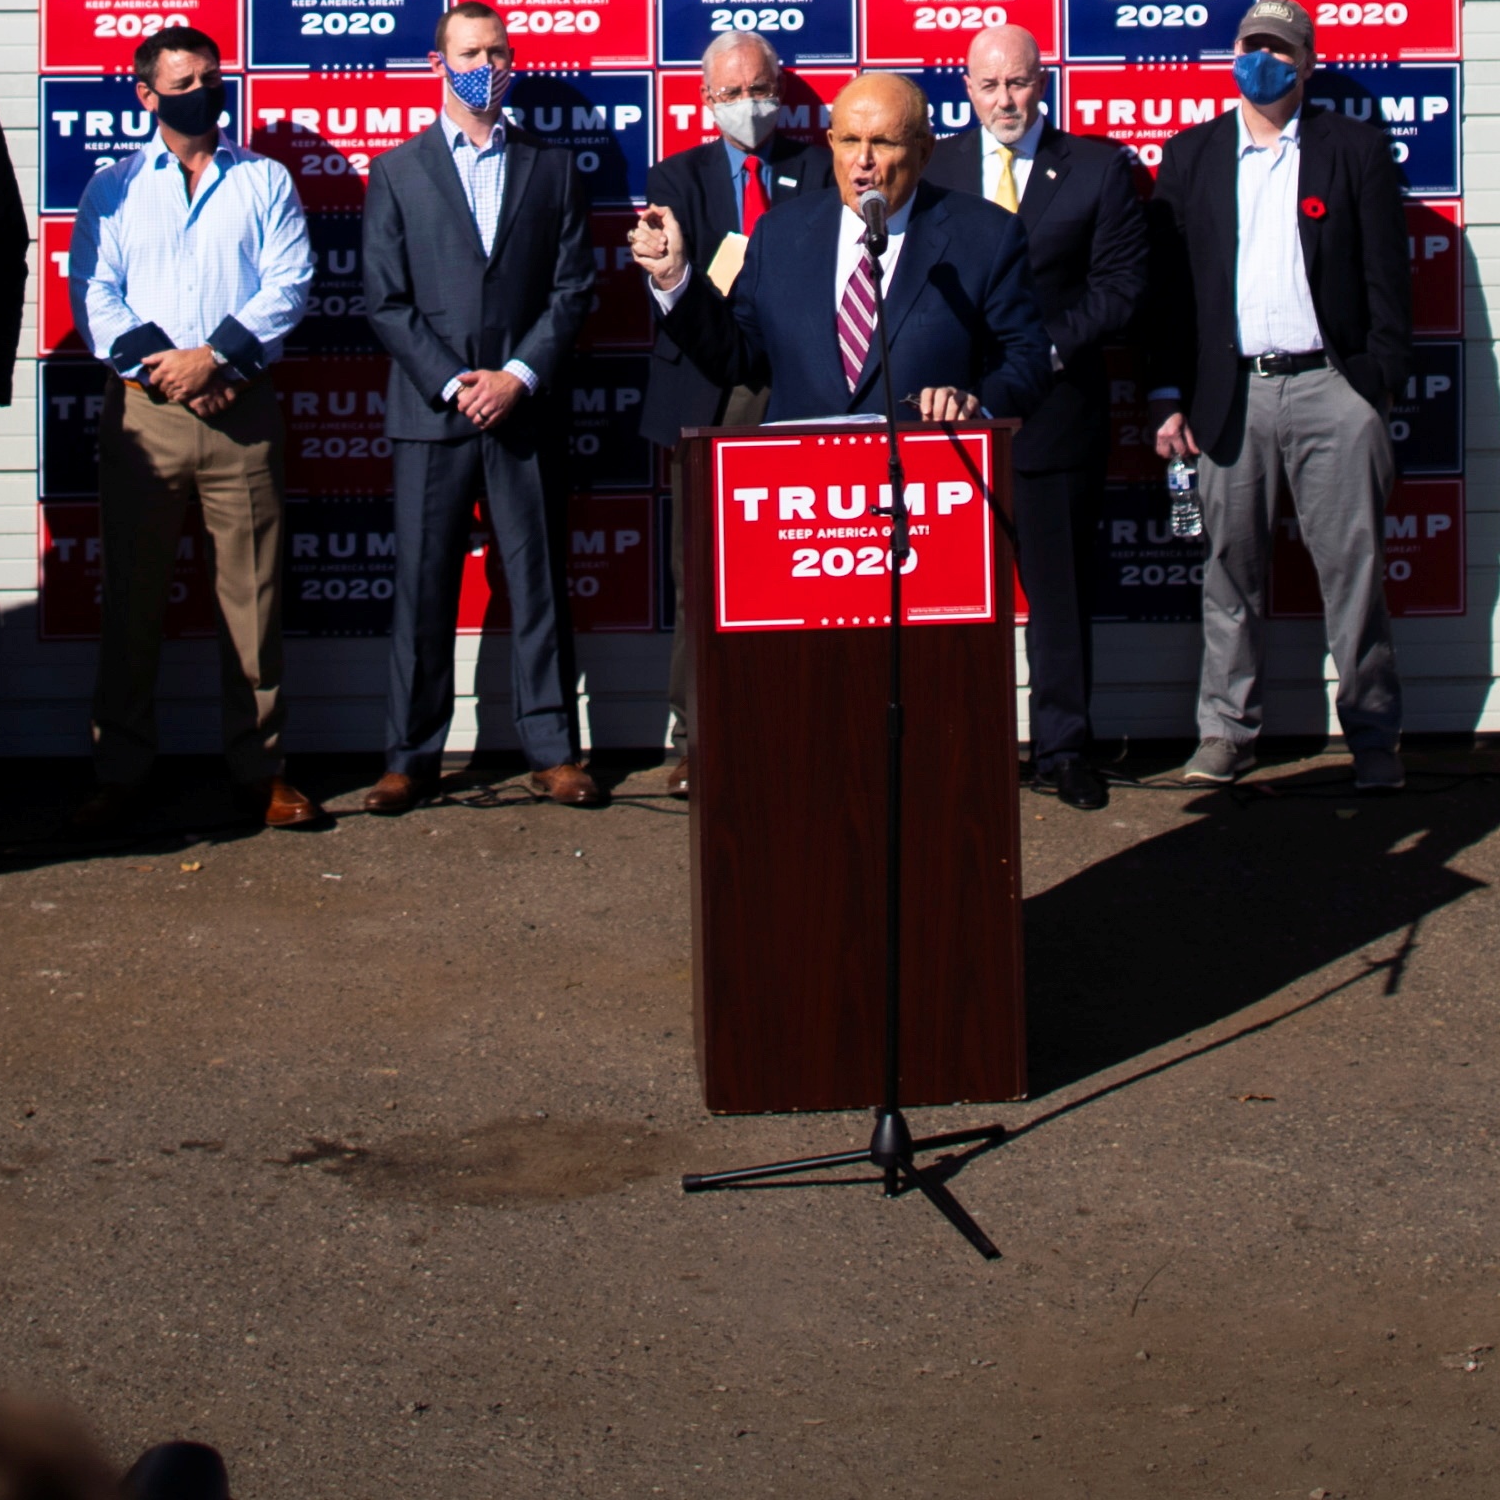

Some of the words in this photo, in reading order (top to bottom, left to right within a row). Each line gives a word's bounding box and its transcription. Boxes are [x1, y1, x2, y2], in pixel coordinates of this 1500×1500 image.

[85, 0, 112, 10] KEEP
[113, 0, 160, 10] AMERICA
[161, 0, 198, 10] GREAT!
[1116, 4, 1210, 28] 2020
[1316, 2, 1408, 26] 2020
[300, 12, 395, 36] 2020
[505, 10, 601, 34] 2020
[710, 8, 805, 32] 2020
[913, 6, 1008, 30] 2020
[257, 105, 438, 134] TRUMP
[85, 141, 112, 151] KEEP
[319, 138, 365, 148] AMERICA
[1107, 130, 1134, 139] KEEP
[300, 152, 370, 175] 202
[305, 295, 367, 317] 202
[300, 436, 394, 459] 2020
[778, 529, 814, 541] KEEP
[816, 527, 878, 539] AMERICA
[881, 525, 930, 537] GAT!
[300, 577, 395, 601] 2020
